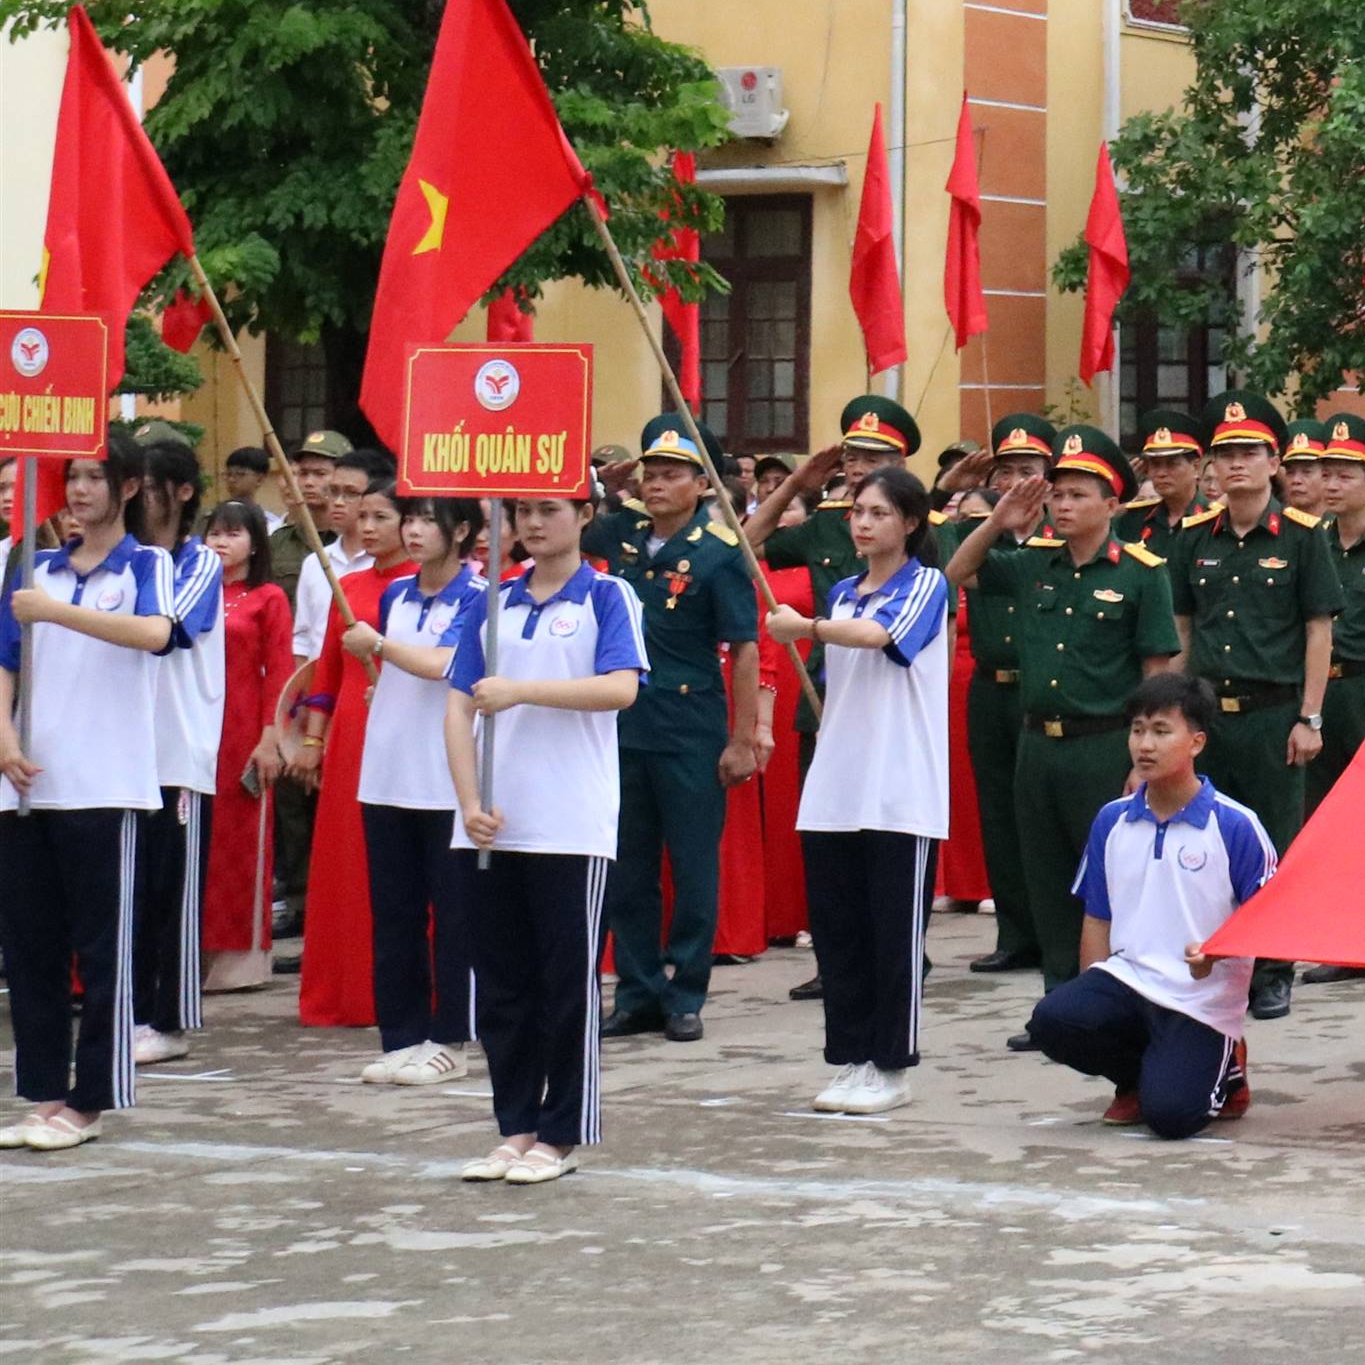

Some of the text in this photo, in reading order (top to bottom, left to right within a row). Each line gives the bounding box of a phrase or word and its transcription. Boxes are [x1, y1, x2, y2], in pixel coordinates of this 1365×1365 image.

[23, 383, 61, 433] CHIẾN
[422, 419, 568, 483] KHỐI QUÂN SỰ
